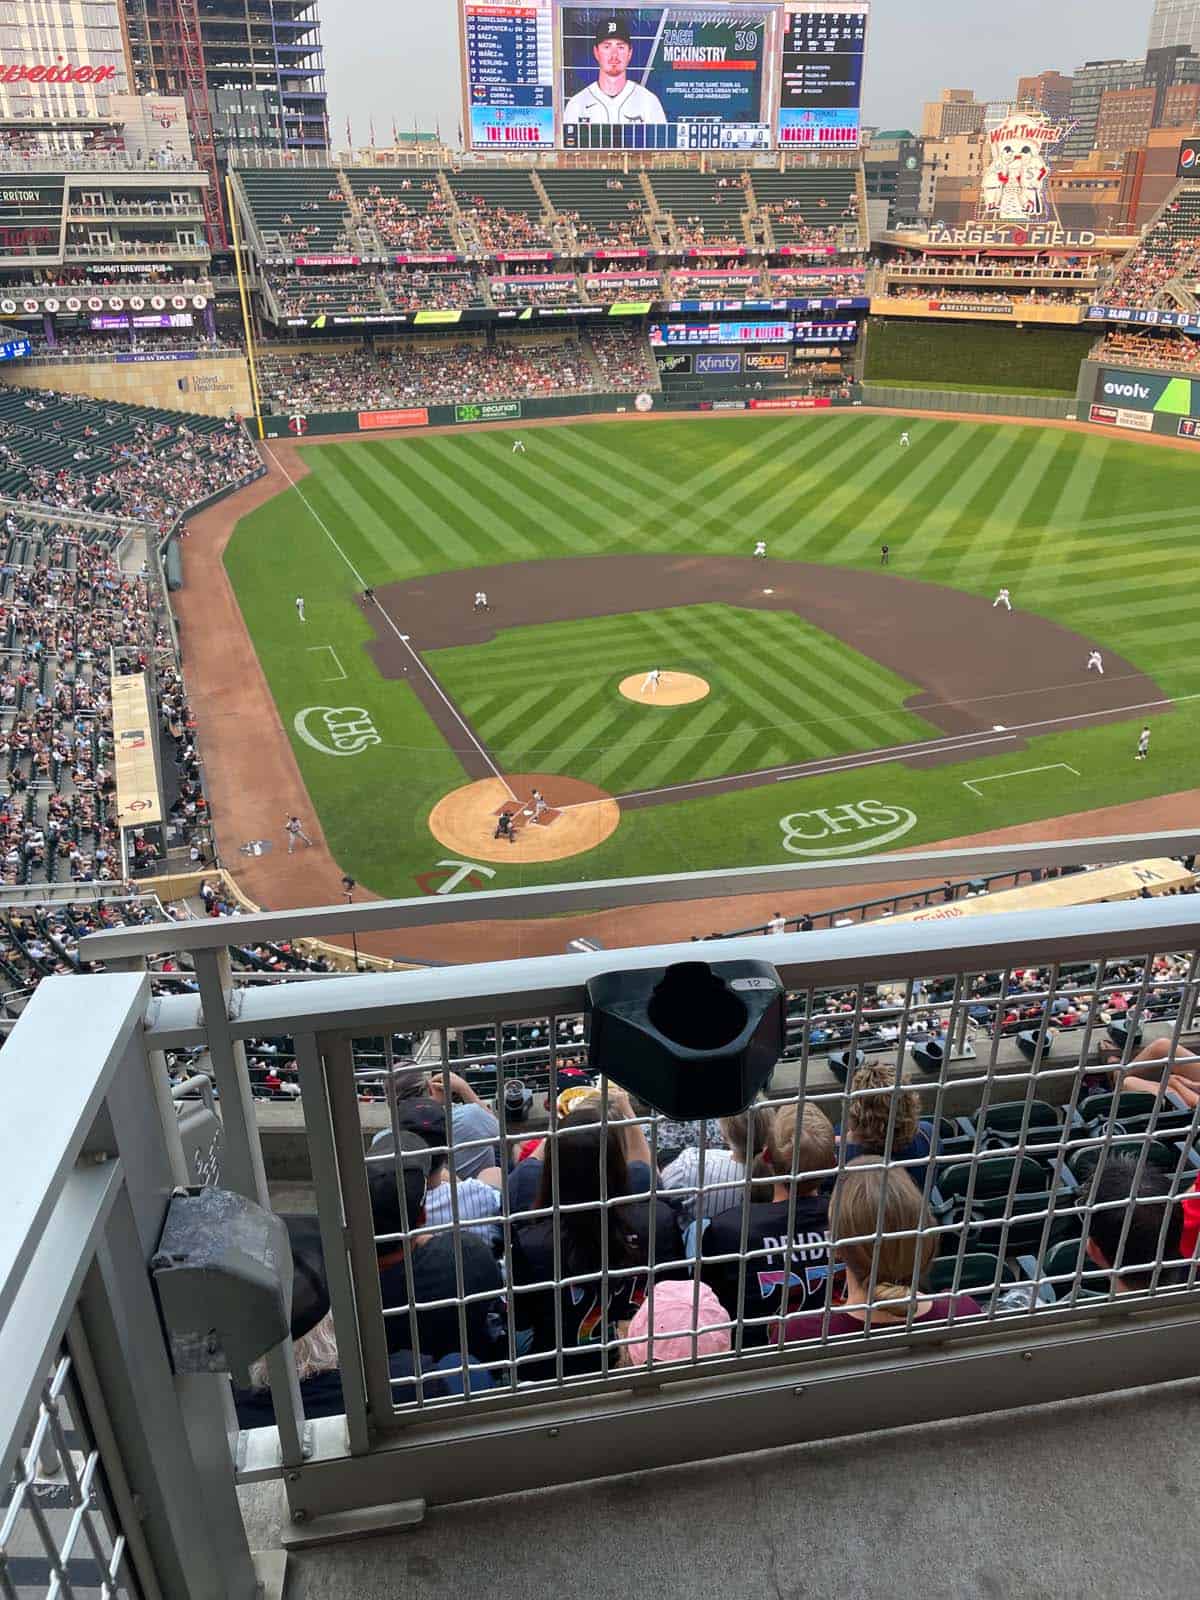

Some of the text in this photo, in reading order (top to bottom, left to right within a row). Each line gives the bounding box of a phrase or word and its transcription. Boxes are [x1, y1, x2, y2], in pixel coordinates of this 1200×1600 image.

[734, 30, 758, 51] 39
[663, 47, 727, 62] MCKINSTRY
[989, 123, 1061, 144] Win! Twins!
[927, 229, 1096, 245] TARGET FIELD
[699, 356, 737, 370] xfinity
[1104, 382, 1150, 399] evolv
[481, 403, 517, 413] securian
[322, 706, 383, 751] CHS
[778, 800, 901, 840] CHS
[746, 979, 761, 988] 12
